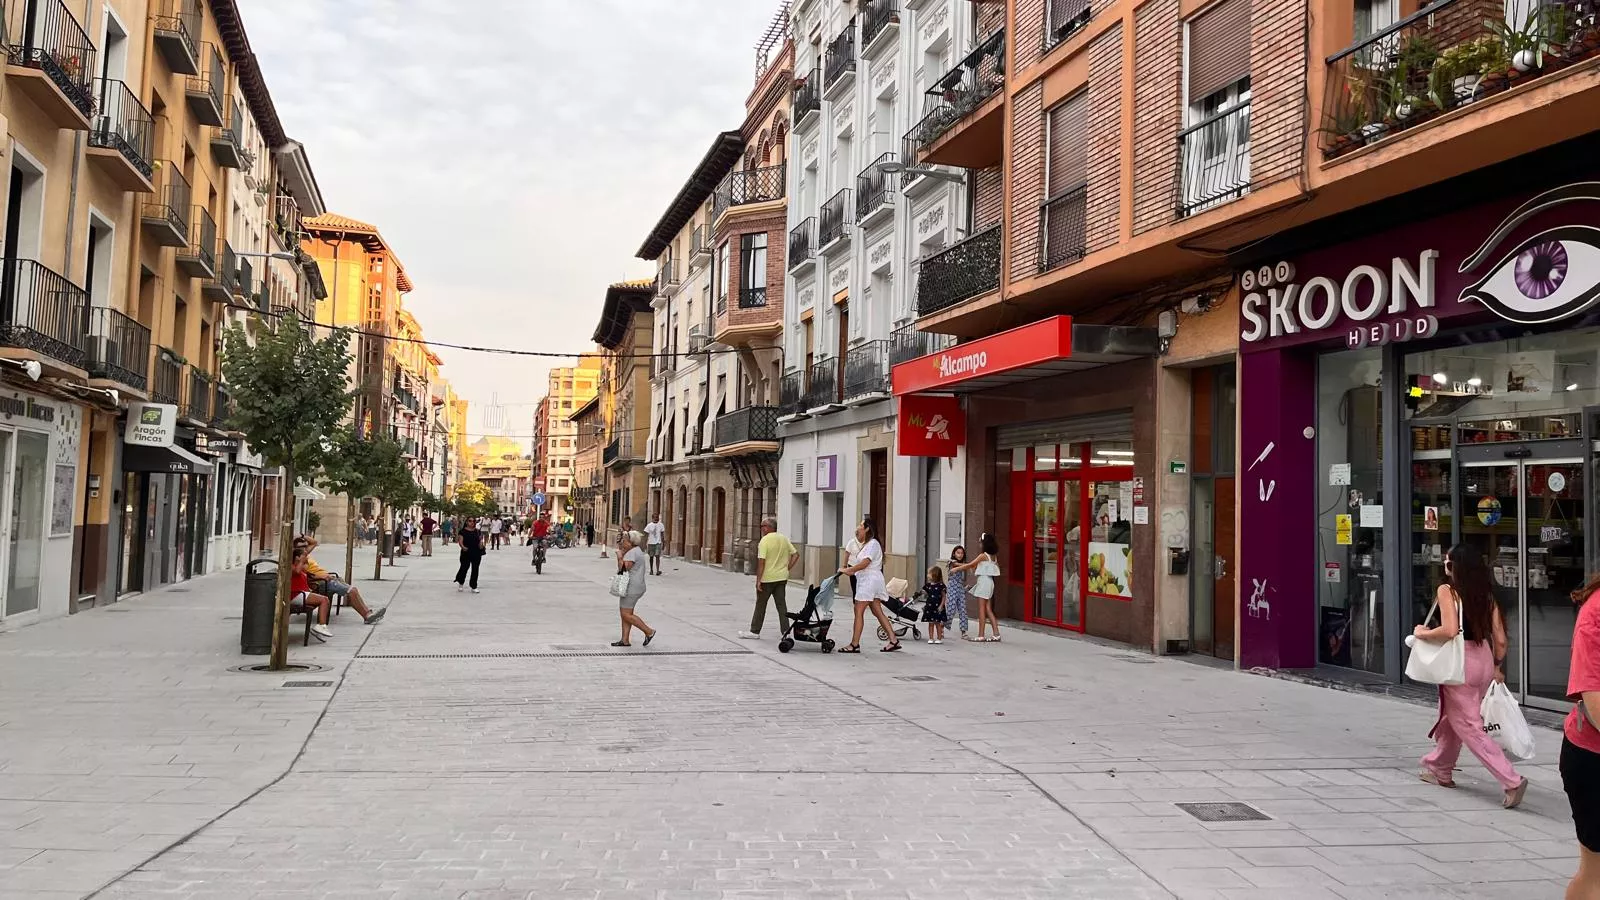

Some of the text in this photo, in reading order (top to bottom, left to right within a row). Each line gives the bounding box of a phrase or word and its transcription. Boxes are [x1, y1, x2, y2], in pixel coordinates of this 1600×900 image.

[1242, 249, 1439, 342] SKOON
[1349, 318, 1430, 345] HEID
[940, 351, 987, 378] Alcampo
[133, 426, 167, 436] Aragón
[134, 434, 163, 443] Fincas
